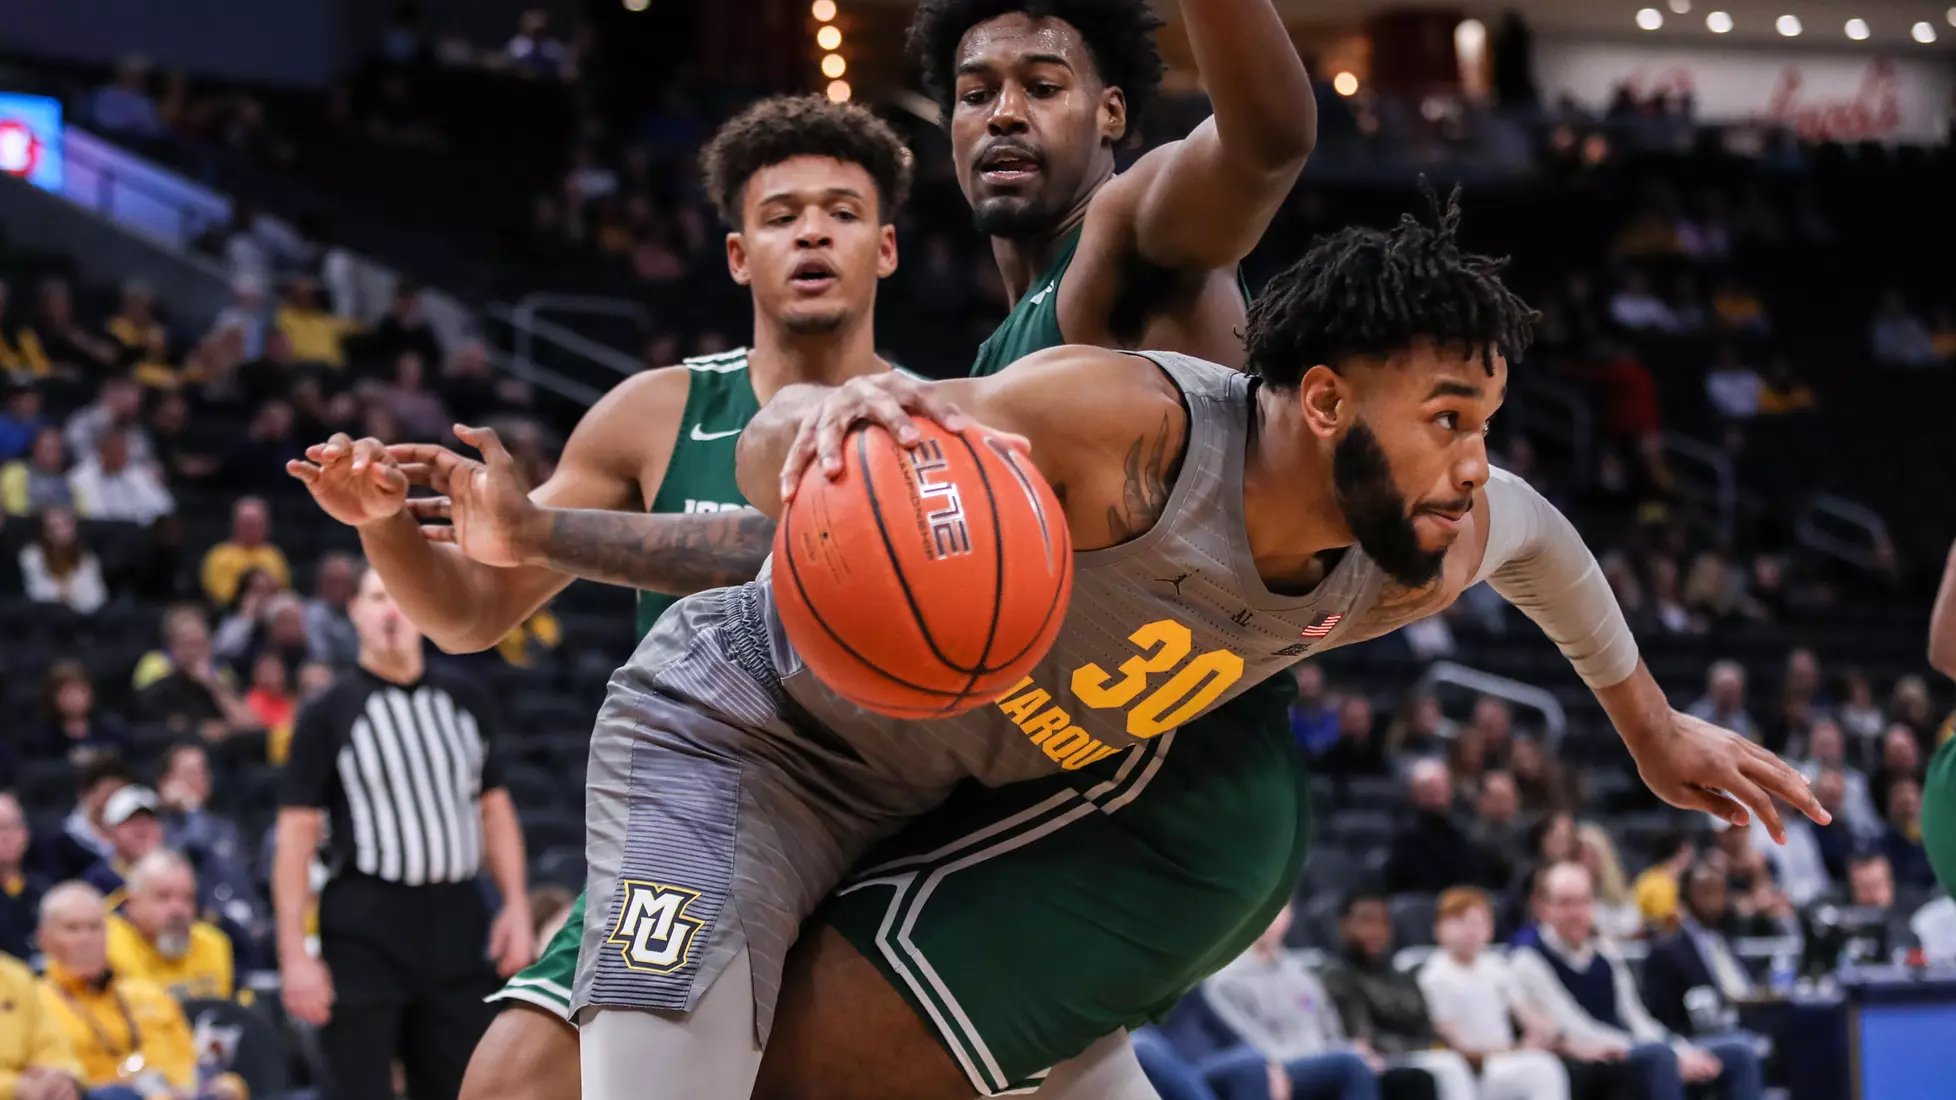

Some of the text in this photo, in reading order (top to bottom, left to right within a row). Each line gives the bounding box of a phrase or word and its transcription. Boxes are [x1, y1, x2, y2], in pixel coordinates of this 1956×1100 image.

[907, 437, 973, 561] ELITE
[993, 675, 1122, 771] ARQU
[1070, 619, 1244, 739] 30
[610, 882, 703, 972] MU
